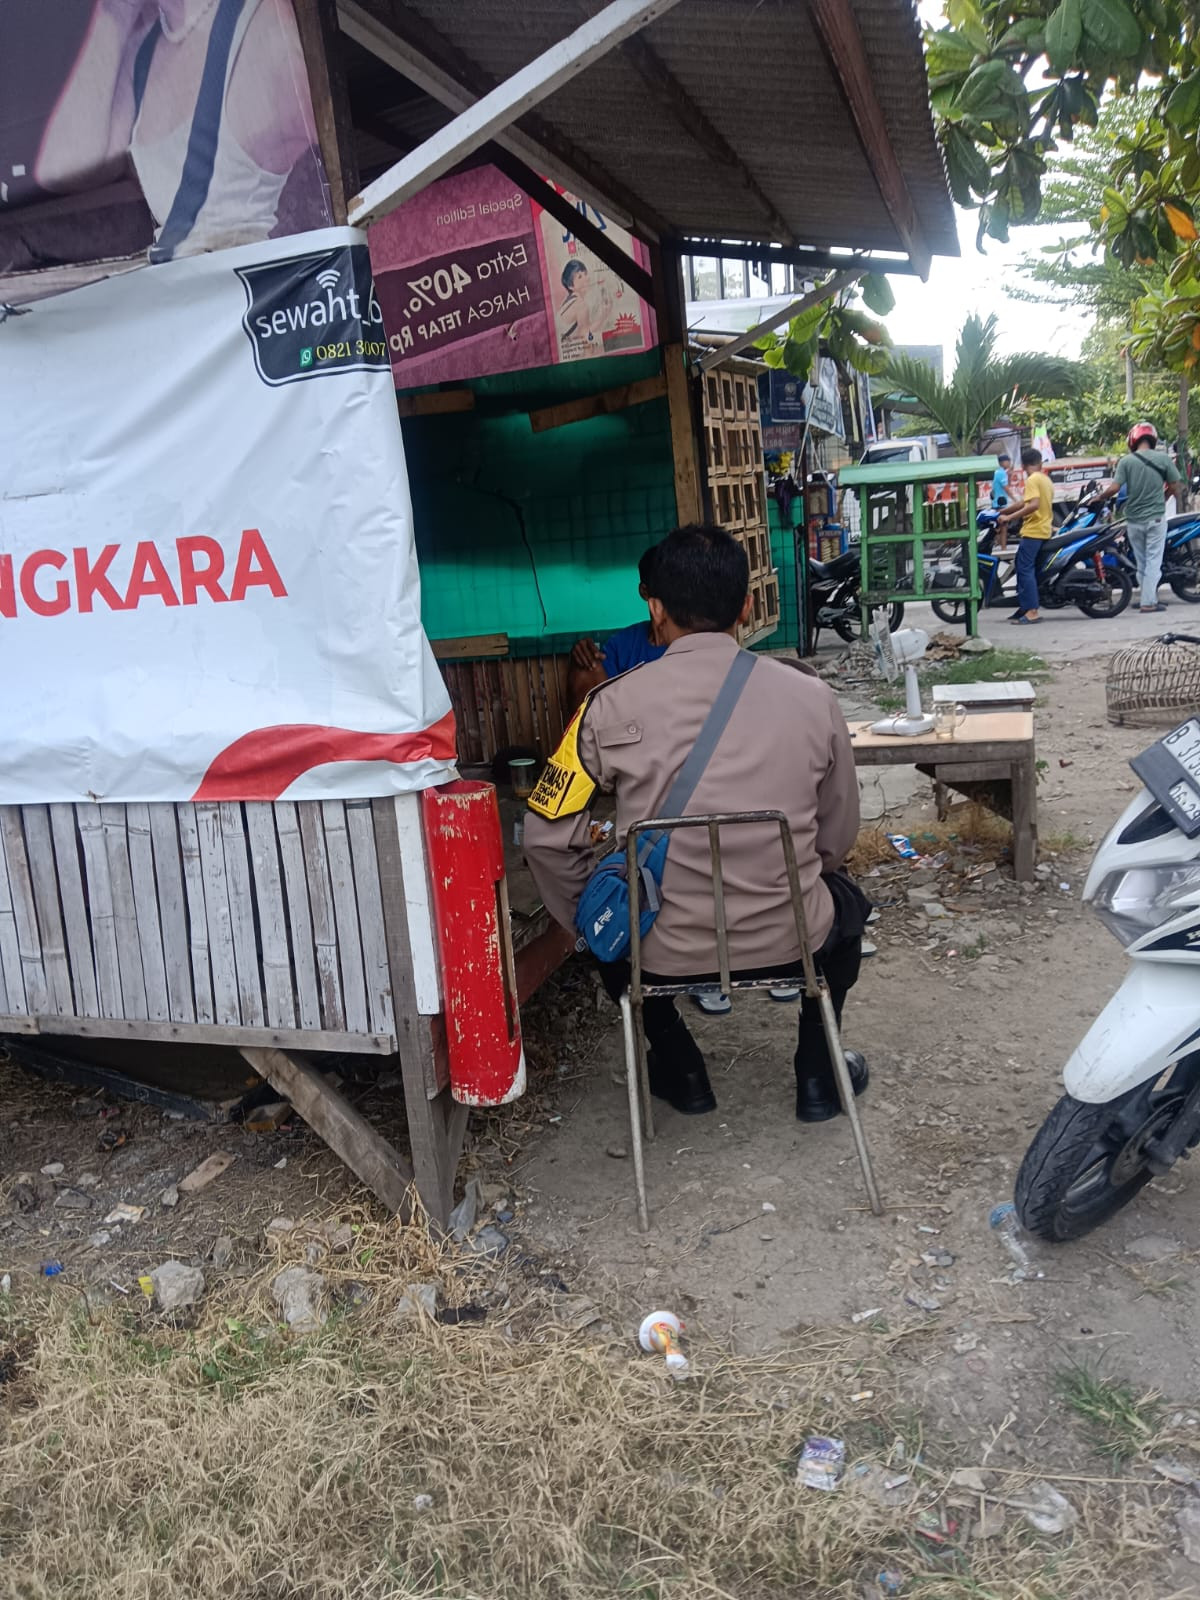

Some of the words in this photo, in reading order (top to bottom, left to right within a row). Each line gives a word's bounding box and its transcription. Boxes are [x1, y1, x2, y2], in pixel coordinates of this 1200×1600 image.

[316, 341, 351, 361] 0821
[355, 339, 386, 357] 3007
[1166, 726, 1190, 745] B
